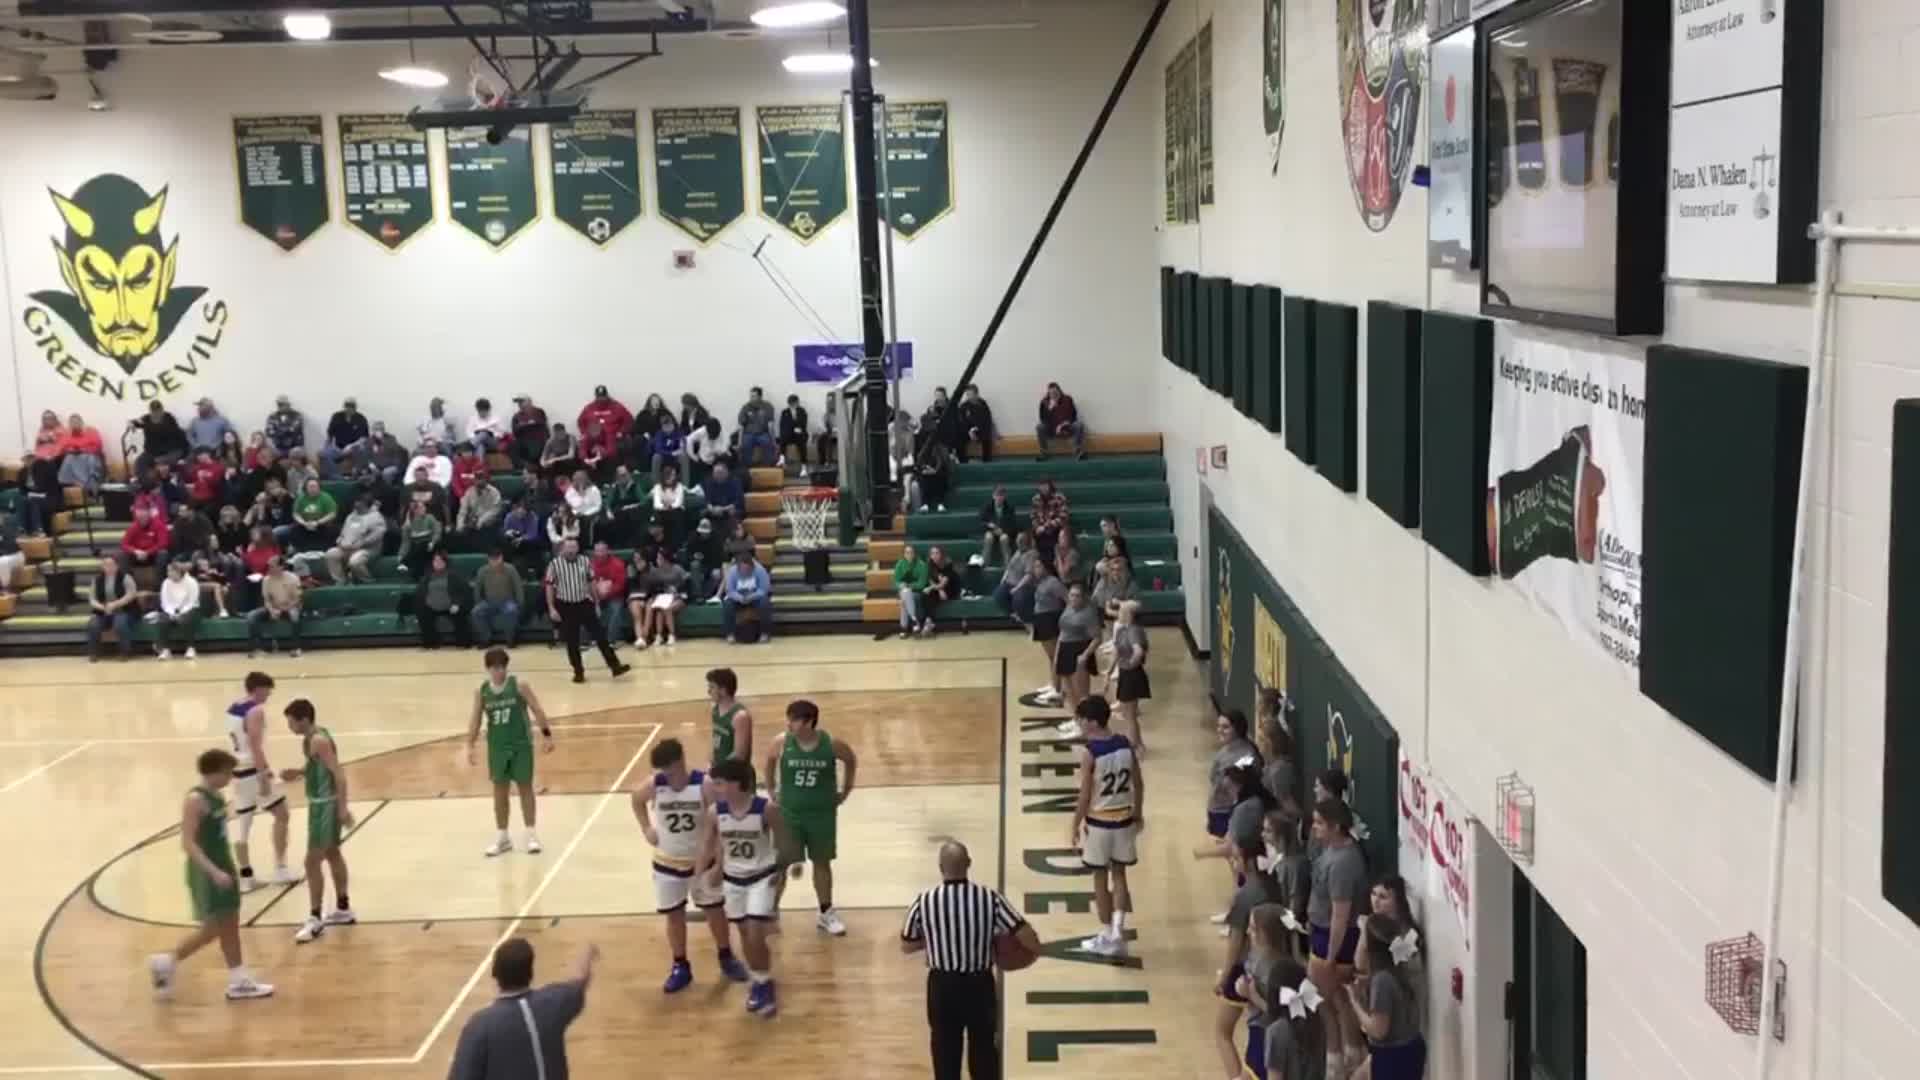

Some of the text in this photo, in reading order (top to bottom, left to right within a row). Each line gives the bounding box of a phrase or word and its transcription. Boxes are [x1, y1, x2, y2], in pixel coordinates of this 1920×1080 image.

[1687, 11, 1744, 40] Attorney at Law
[1672, 167, 1695, 190] Dana
[1709, 162, 1747, 186] Whalen
[1680, 202, 1711, 222] Attorney
[1720, 200, 1737, 216] Law
[23, 299, 229, 400] GREEN DEVILS
[1500, 355, 1532, 392] Keeping
[1533, 370, 1549, 395] you
[1551, 368, 1579, 398] active
[794, 770, 818, 787] 55
[1101, 767, 1131, 797] 22
[665, 812, 697, 834] 23
[728, 840, 755, 860] 20
